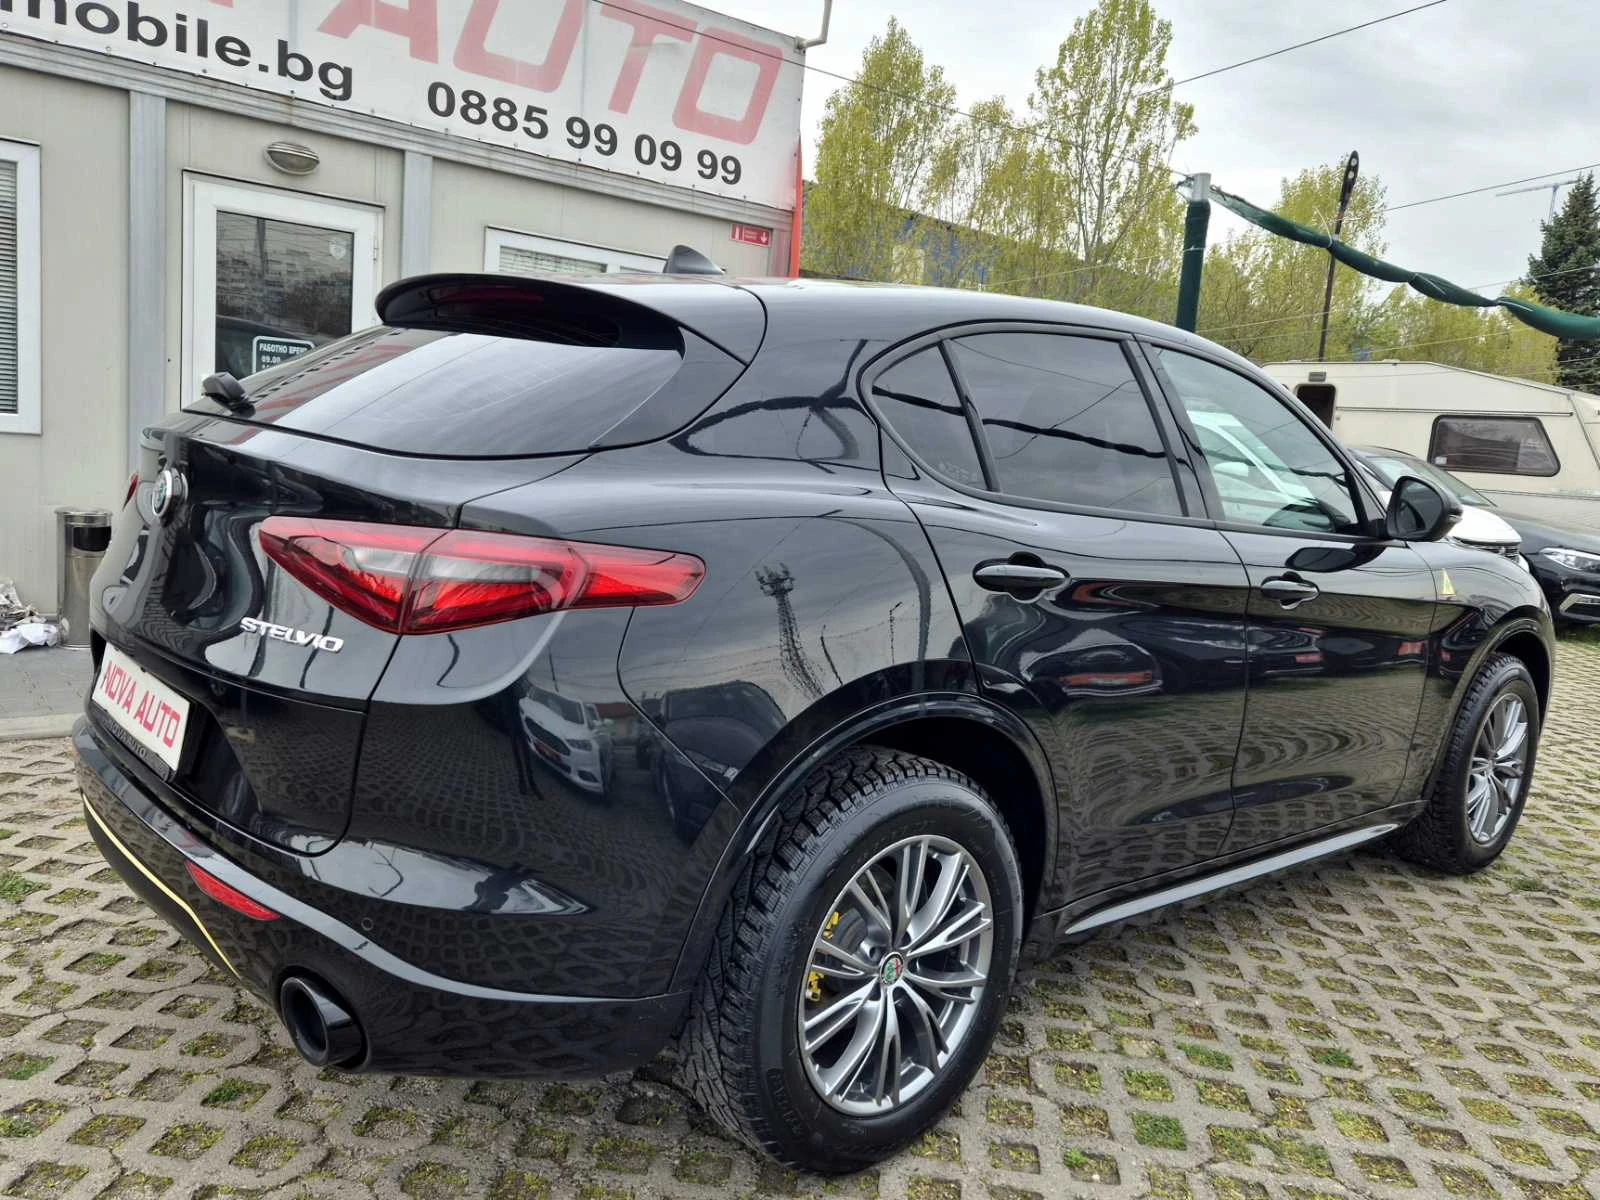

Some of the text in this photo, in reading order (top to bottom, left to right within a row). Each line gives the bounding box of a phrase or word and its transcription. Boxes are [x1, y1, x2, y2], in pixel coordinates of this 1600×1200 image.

[317, 0, 783, 145] AUTO
[427, 81, 742, 185] 0885 99 09 99
[259, 343, 288, 353] РАБОТНО
[240, 616, 344, 654] STELVIO
[101, 660, 181, 748] NOVA AUTO
